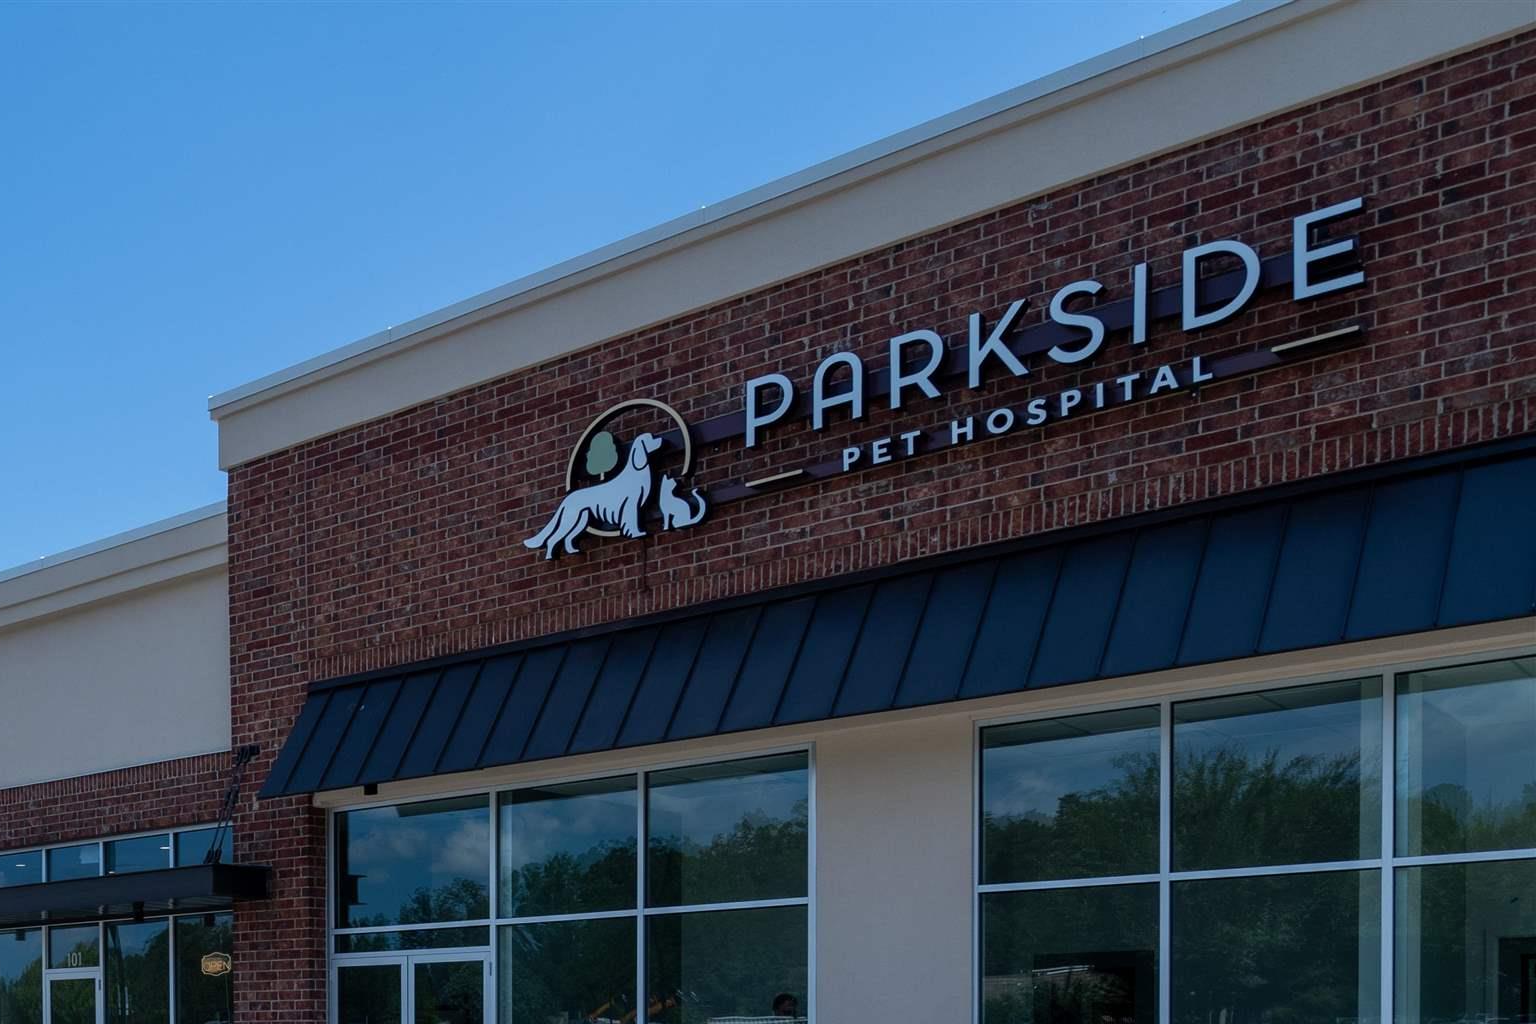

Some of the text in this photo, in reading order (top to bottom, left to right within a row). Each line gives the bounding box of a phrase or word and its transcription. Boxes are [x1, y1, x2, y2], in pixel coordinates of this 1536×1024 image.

[744, 197, 1367, 449] PARKSIDE
[842, 355, 1214, 473] PET HOSPITAL
[67, 951, 82, 967] 101
